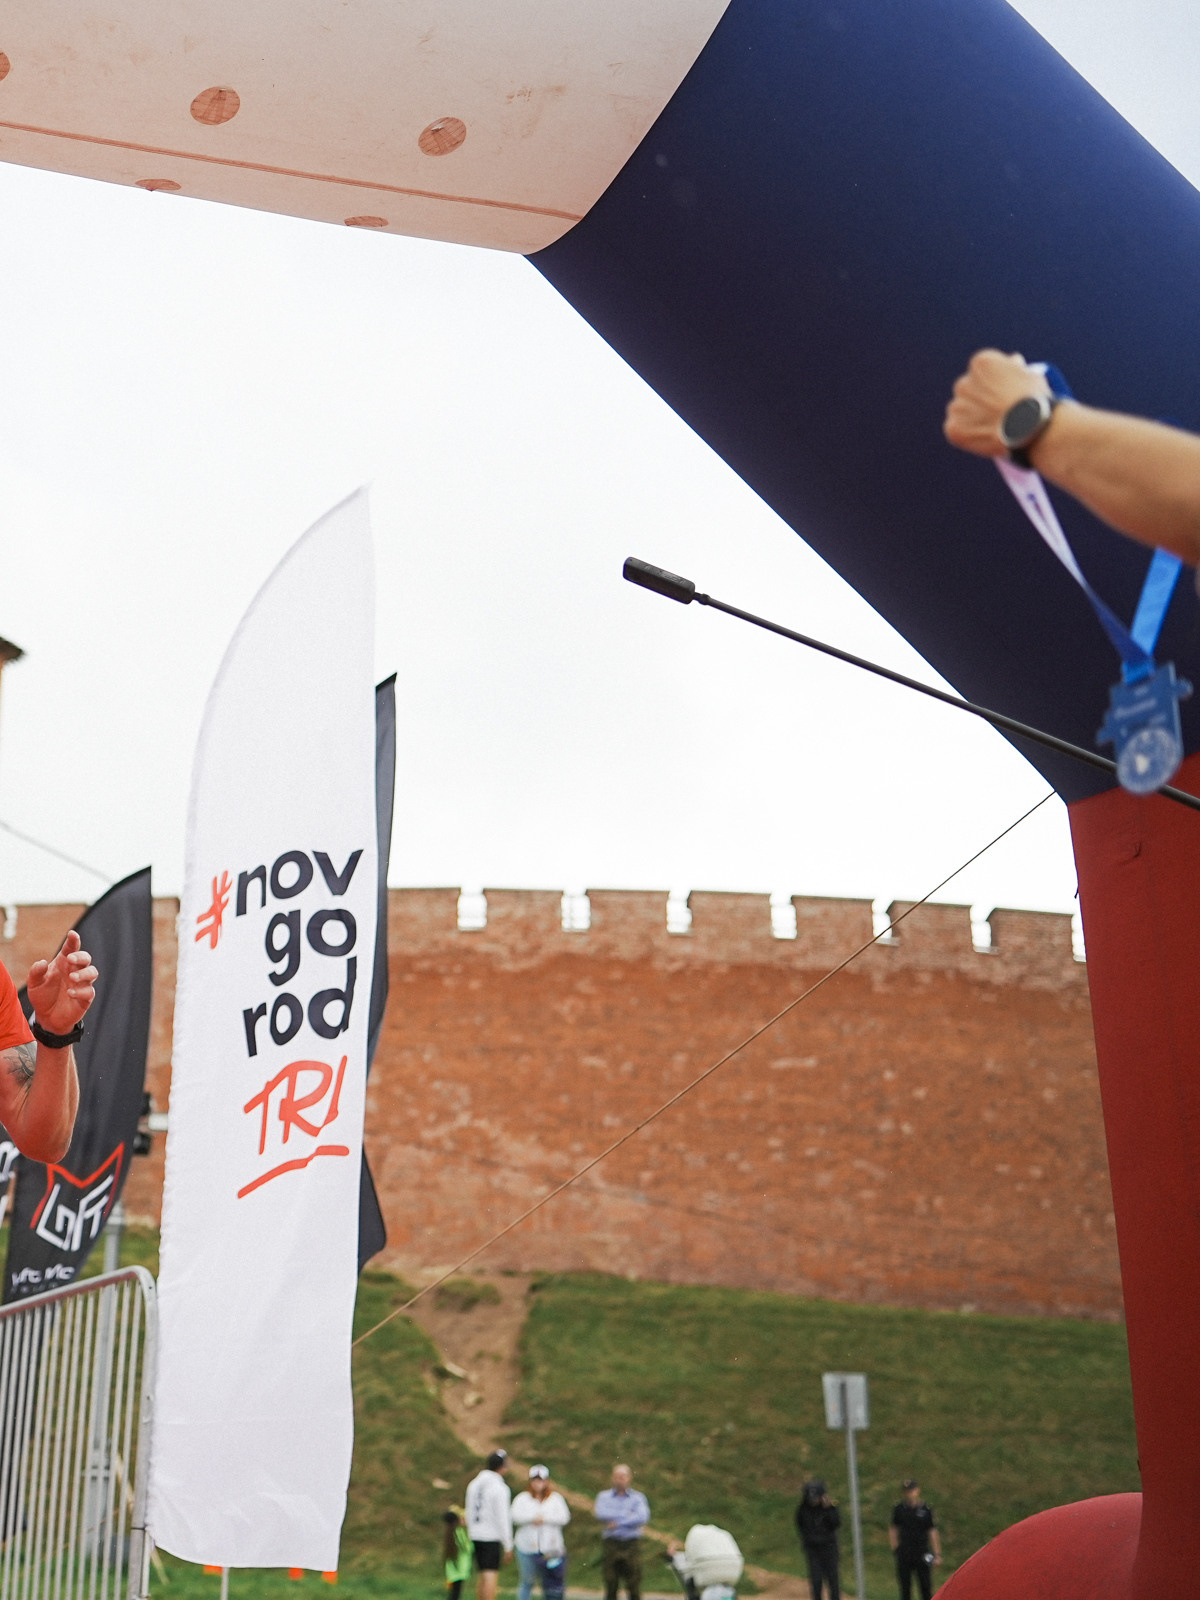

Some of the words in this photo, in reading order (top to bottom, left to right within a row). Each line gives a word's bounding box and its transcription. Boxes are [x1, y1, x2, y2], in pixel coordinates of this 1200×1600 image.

[195, 849, 364, 949] #nov
[265, 908, 357, 986] go
[242, 956, 358, 1057] rod
[243, 1055, 348, 1155] TRI
